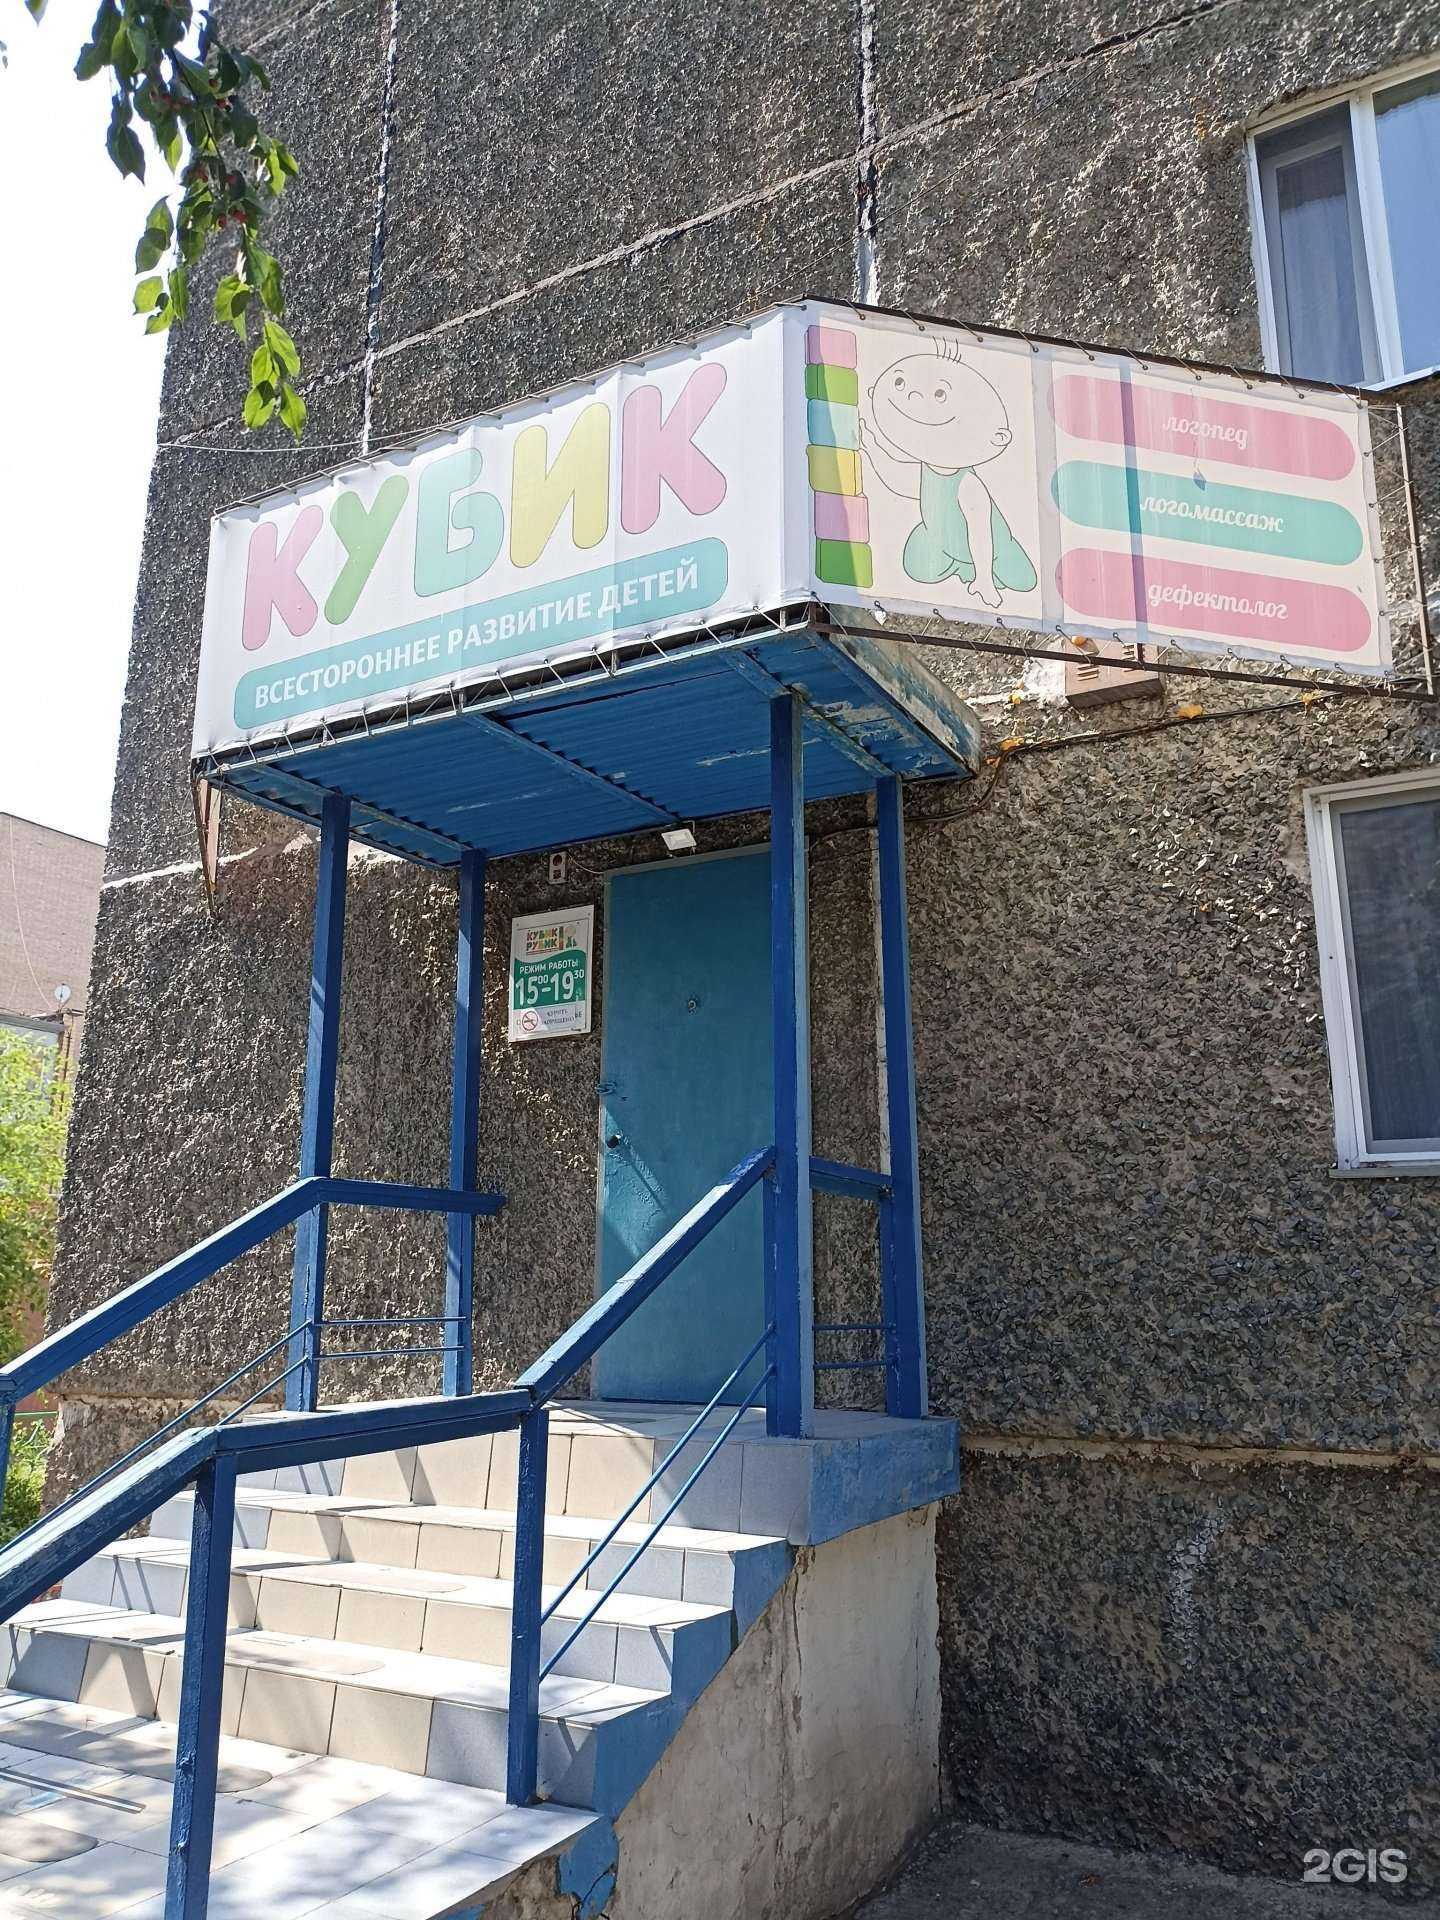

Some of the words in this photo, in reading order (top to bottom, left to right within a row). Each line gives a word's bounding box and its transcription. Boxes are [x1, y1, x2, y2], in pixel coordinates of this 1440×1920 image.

[1163, 416, 1249, 450] логопед
[242, 362, 728, 651] КУБИК
[1141, 496, 1285, 533] логомассаж
[1148, 583, 1289, 620] дефектолог
[255, 634, 439, 710] ВСЕСТОРОННЕЕ
[447, 591, 592, 655] РАЗВИТИЕ
[598, 557, 698, 619] ДЕТЕЙ
[519, 964, 547, 975] РЕЖИМ
[548, 959, 579, 970] РАБОТЫ
